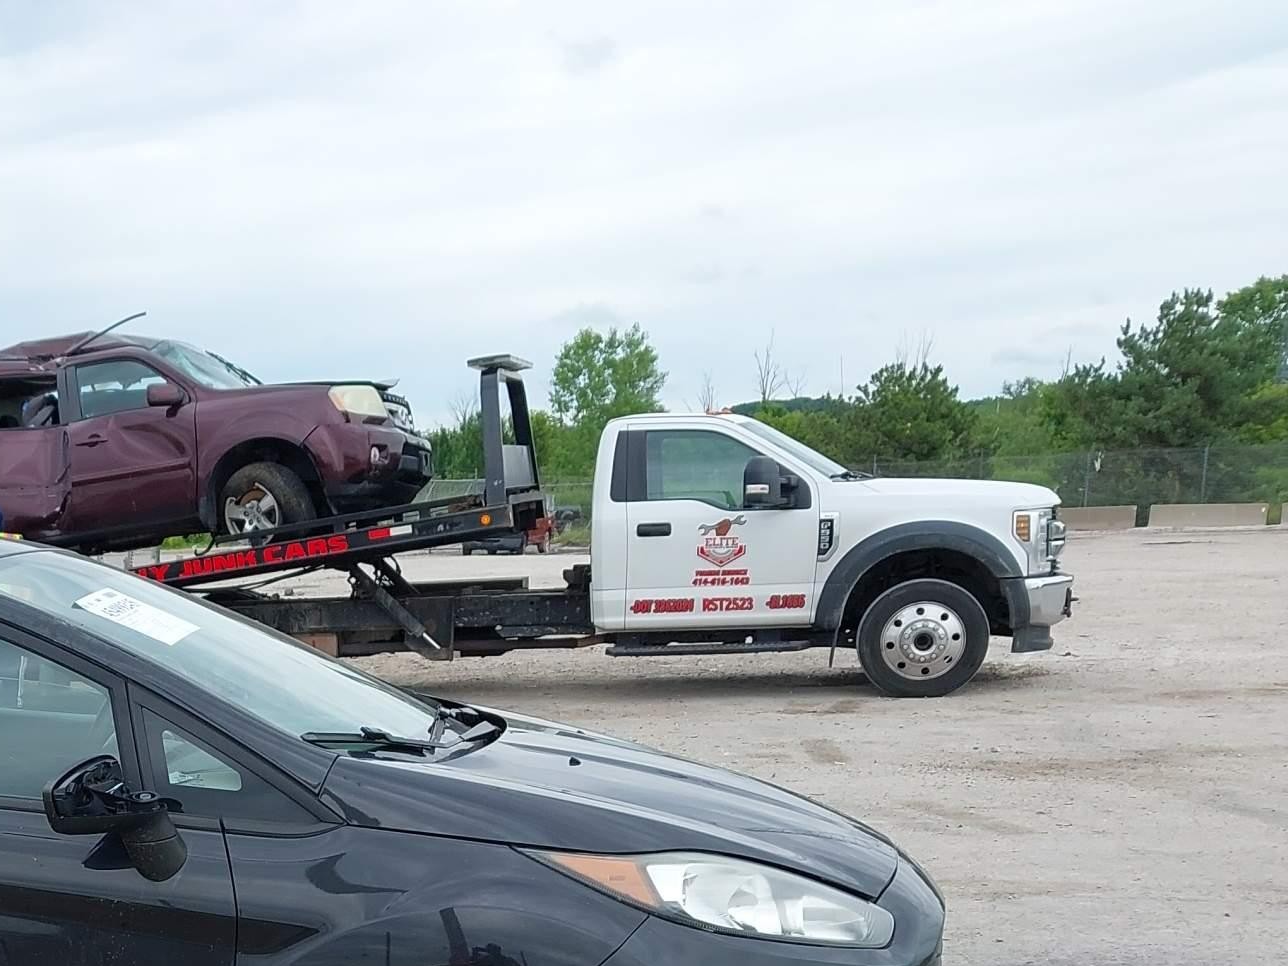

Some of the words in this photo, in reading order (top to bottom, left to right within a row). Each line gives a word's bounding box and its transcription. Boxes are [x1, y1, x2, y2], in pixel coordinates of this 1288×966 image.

[705, 537, 739, 546] ELITE
[180, 549, 258, 578] JUNK
[262, 534, 349, 565] CARS
[702, 597, 754, 612] RST2523
